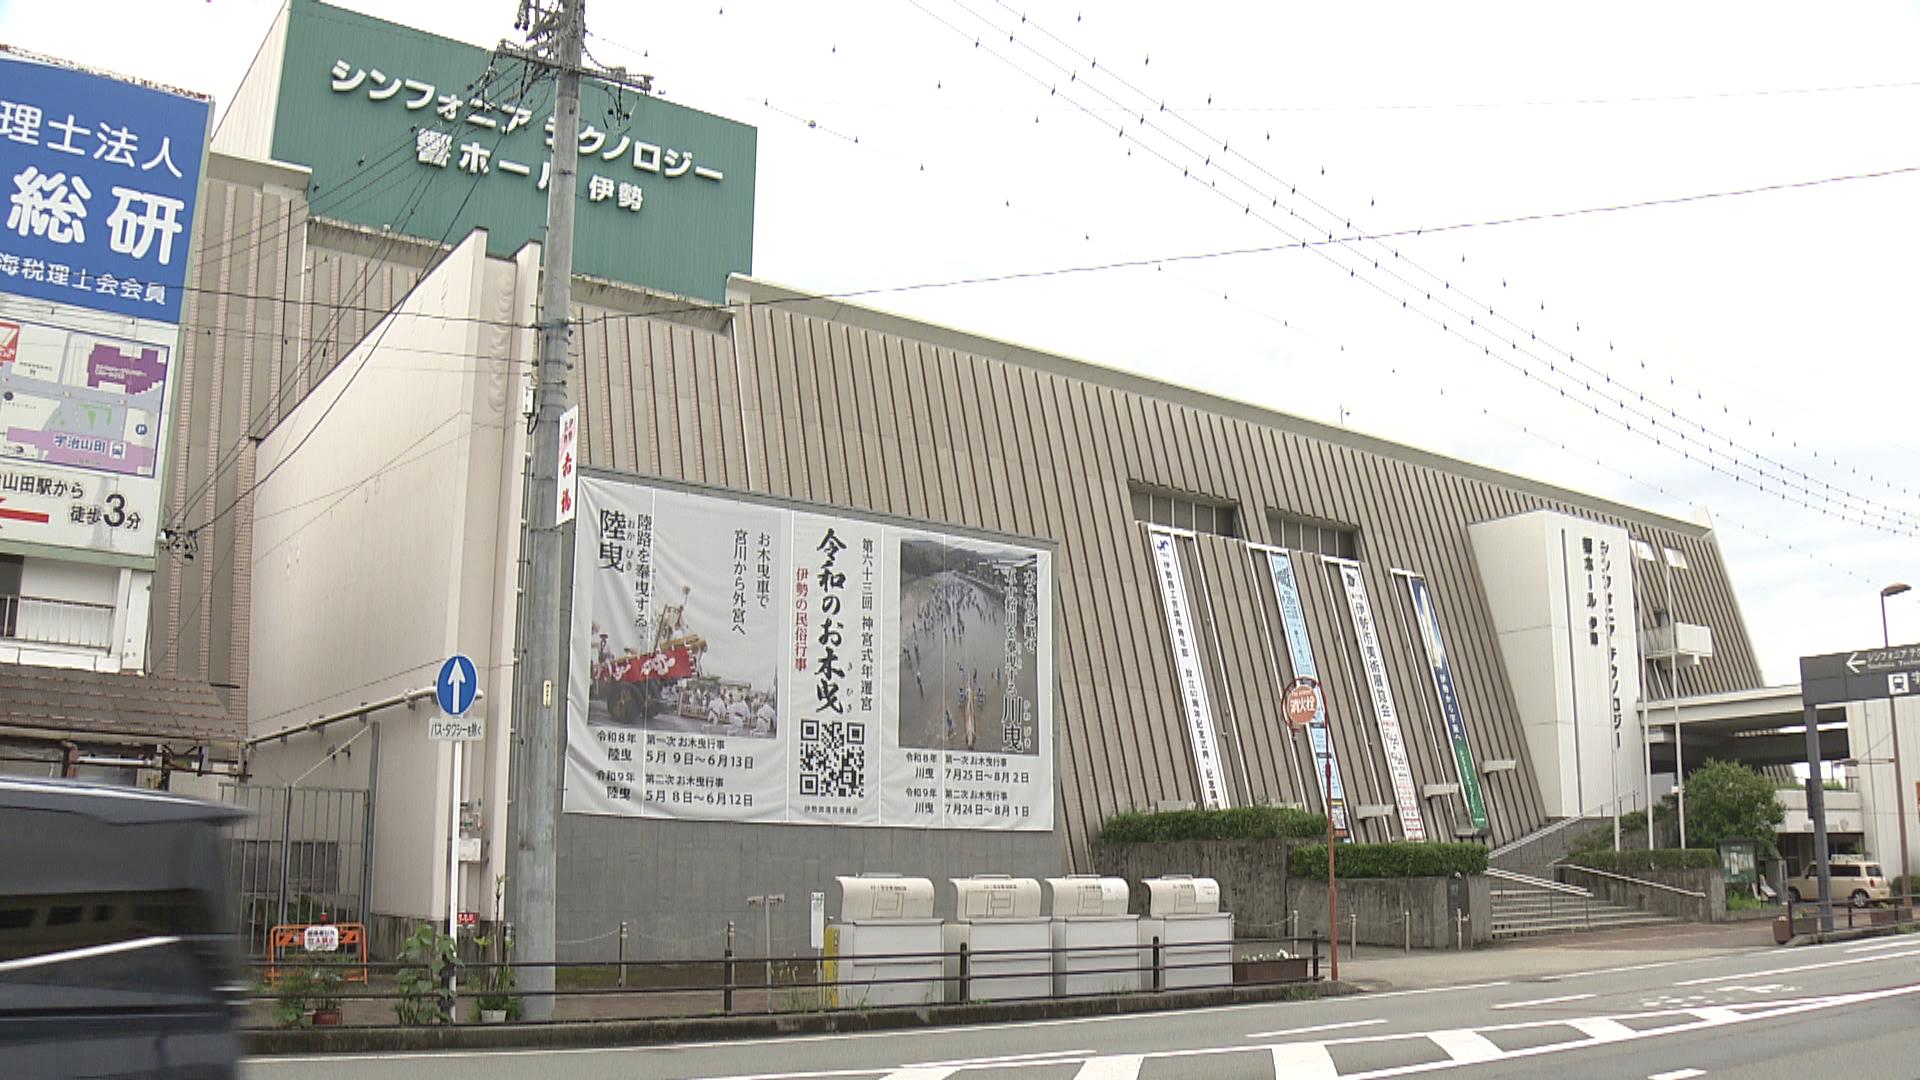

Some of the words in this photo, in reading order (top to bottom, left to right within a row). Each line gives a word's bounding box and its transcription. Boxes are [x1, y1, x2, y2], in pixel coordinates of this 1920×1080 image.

[0, 102, 183, 178] 理士法人
[332, 60, 532, 135] シンフォニア
[544, 116, 724, 181] クノロジー
[6, 166, 186, 266] 総研
[589, 174, 643, 212] 伊勢
[0, 472, 84, 499] 山田駅から
[70, 494, 142, 530] 徒歩3分
[599, 508, 626, 573] 陸曳
[731, 527, 749, 636] 宮川から外宮へ
[756, 531, 771, 609] お木曳車で
[860, 537, 874, 611] 第六十三回
[795, 566, 809, 672] 伊勢の民俗行事
[814, 527, 847, 715] 令和のお木曳
[860, 615, 874, 711] 神宮式年遷宮
[597, 730, 637, 744] 令和8年
[608, 748, 632, 762] 陸曳
[906, 752, 937, 763] 令和8年
[596, 770, 635, 783] 令和9年
[906, 786, 937, 797] 令和9年
[915, 768, 934, 779] 川曳
[915, 802, 934, 814] 川曳
